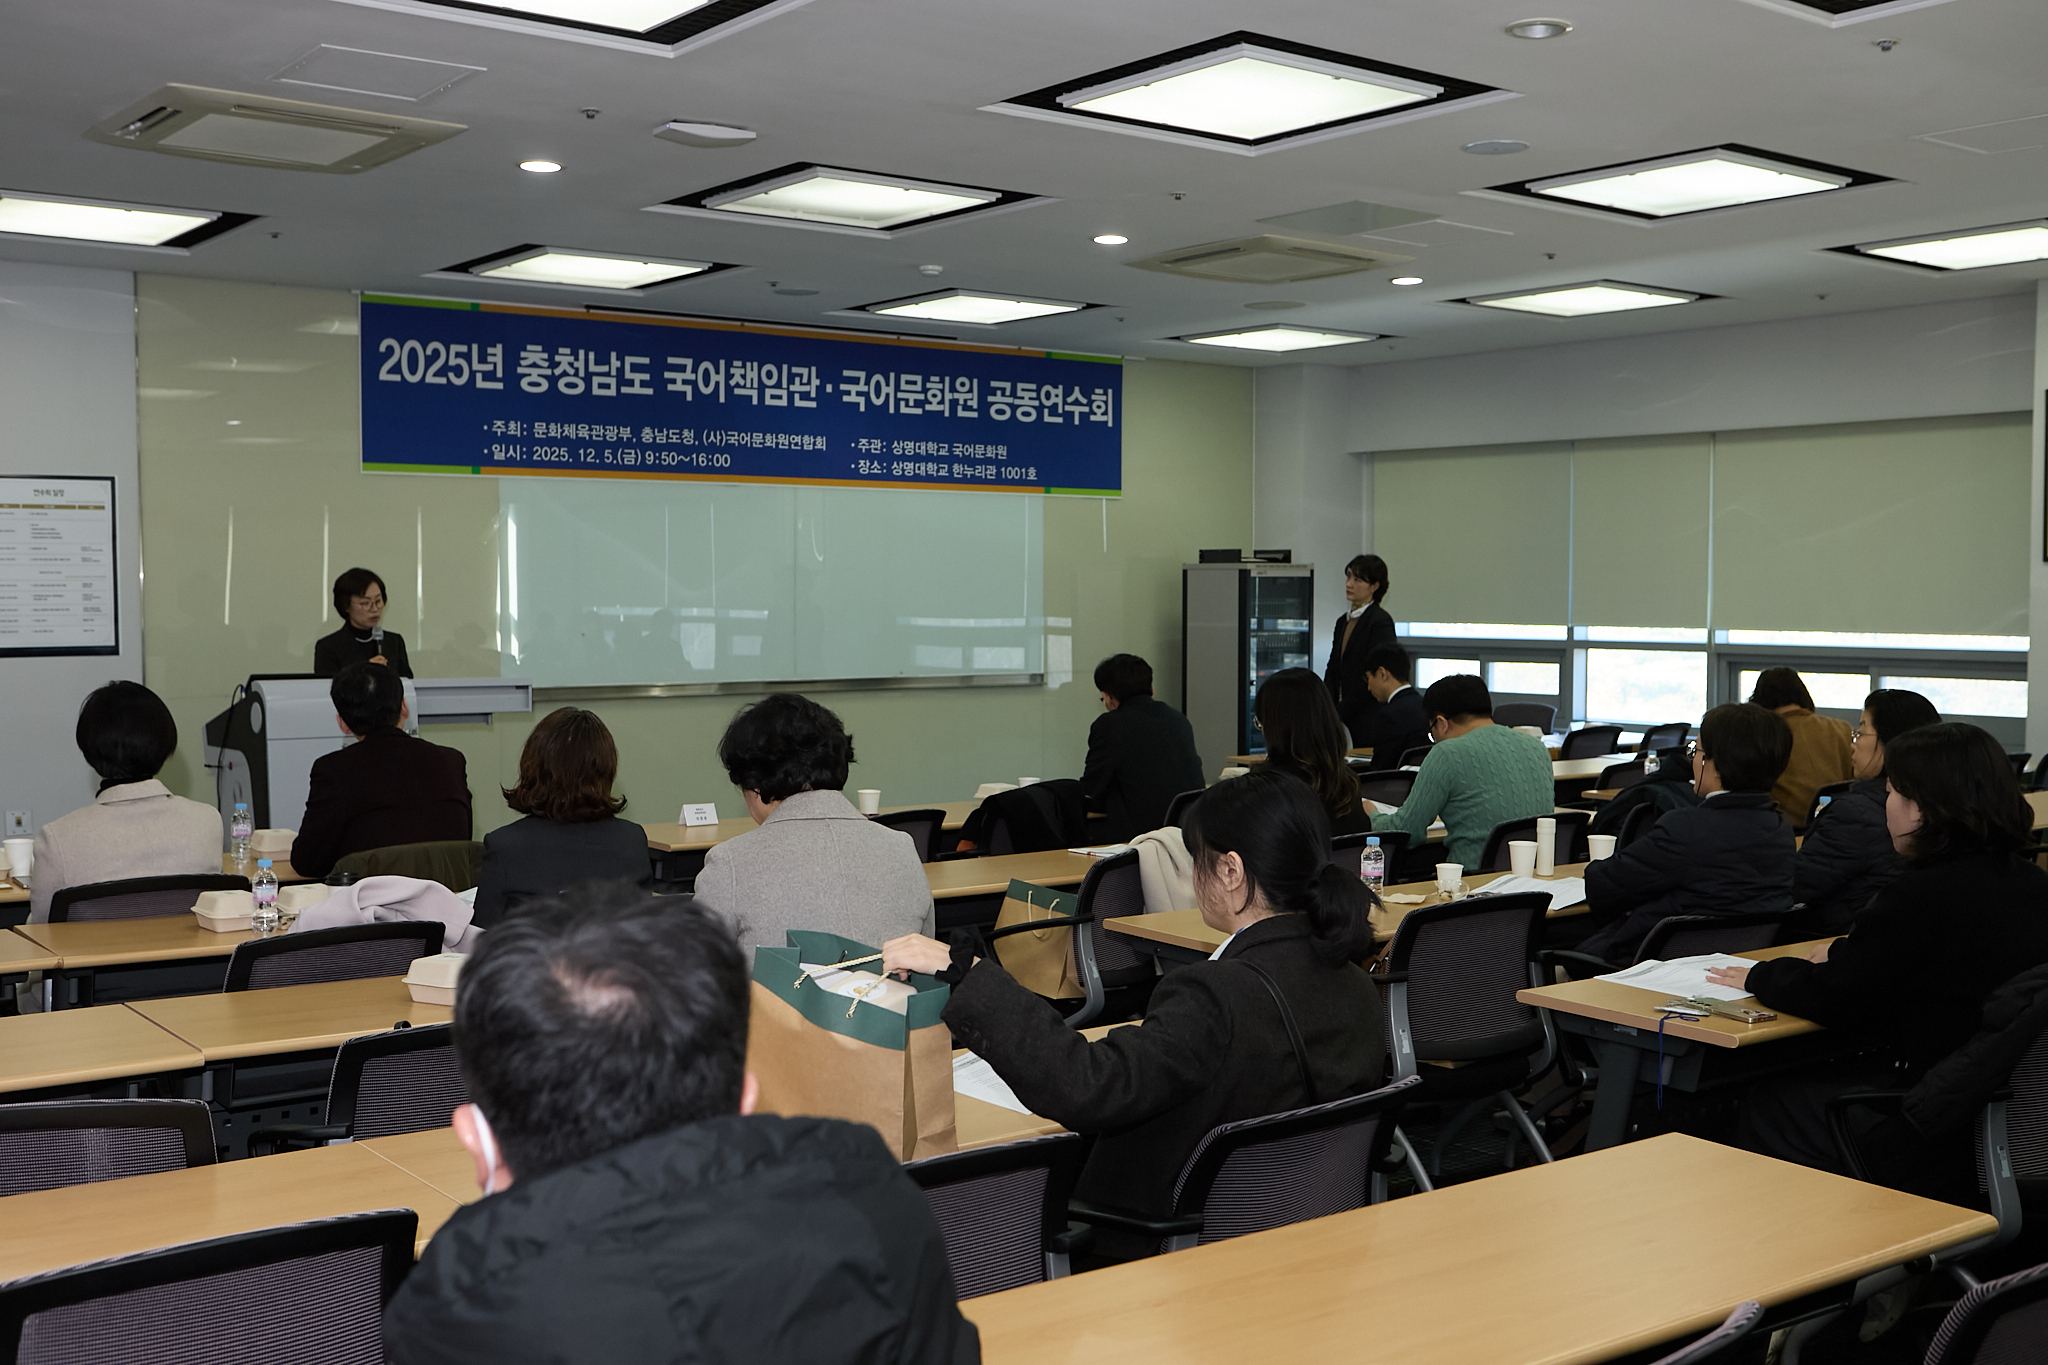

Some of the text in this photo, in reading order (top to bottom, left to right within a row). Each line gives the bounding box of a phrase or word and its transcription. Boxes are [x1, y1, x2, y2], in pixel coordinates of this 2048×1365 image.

[378, 338, 504, 390] 2025년
[516, 344, 654, 396] 충청남도
[987, 380, 1113, 427] 공동연수회
[491, 420, 527, 437] 주최:
[533, 422, 637, 443] 문화체육관광부,
[640, 426, 698, 446] 충남도청,
[491, 443, 527, 461] 일시:
[532, 446, 573, 463] 2025.
[857, 438, 1007, 460] 주관: 상명대학교 국어문화원
[857, 459, 1038, 481] 장소: 상명대학교 한누리관 1001호
